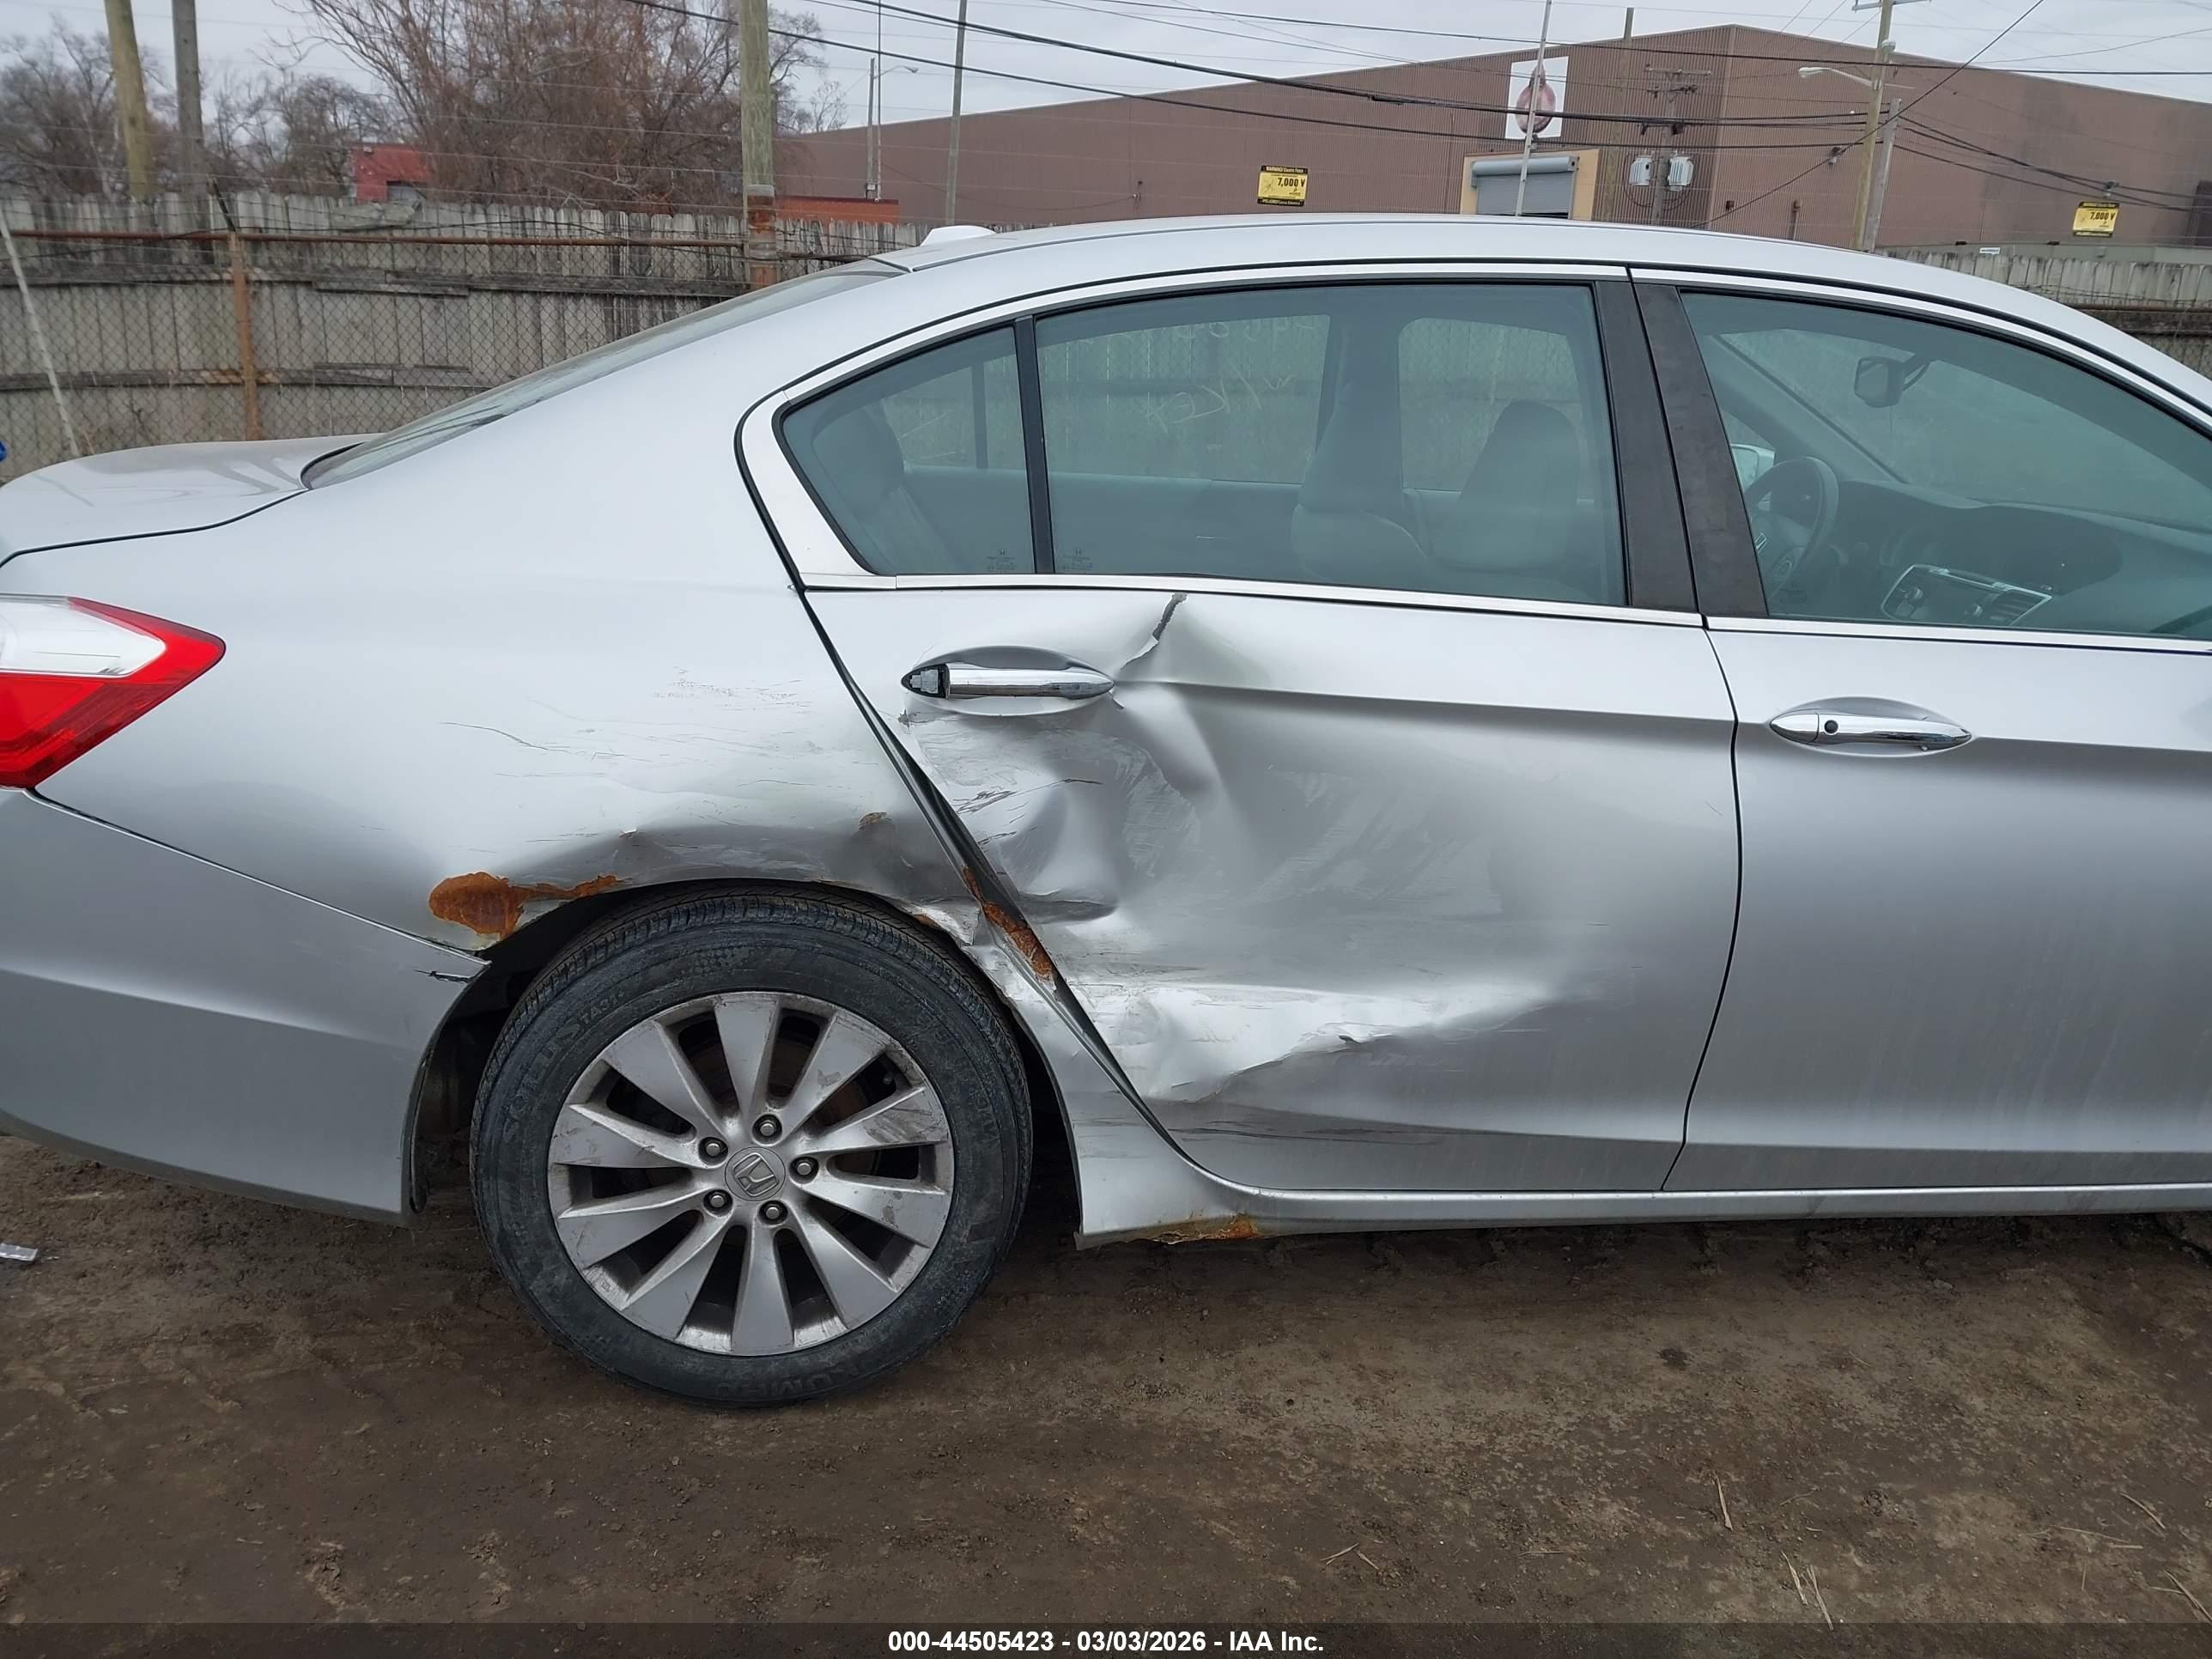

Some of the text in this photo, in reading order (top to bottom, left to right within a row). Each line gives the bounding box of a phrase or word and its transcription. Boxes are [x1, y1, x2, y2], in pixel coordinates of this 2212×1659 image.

[1277, 177, 1305, 187] 7,000 V
[2089, 211, 2116, 221] 7,000 V
